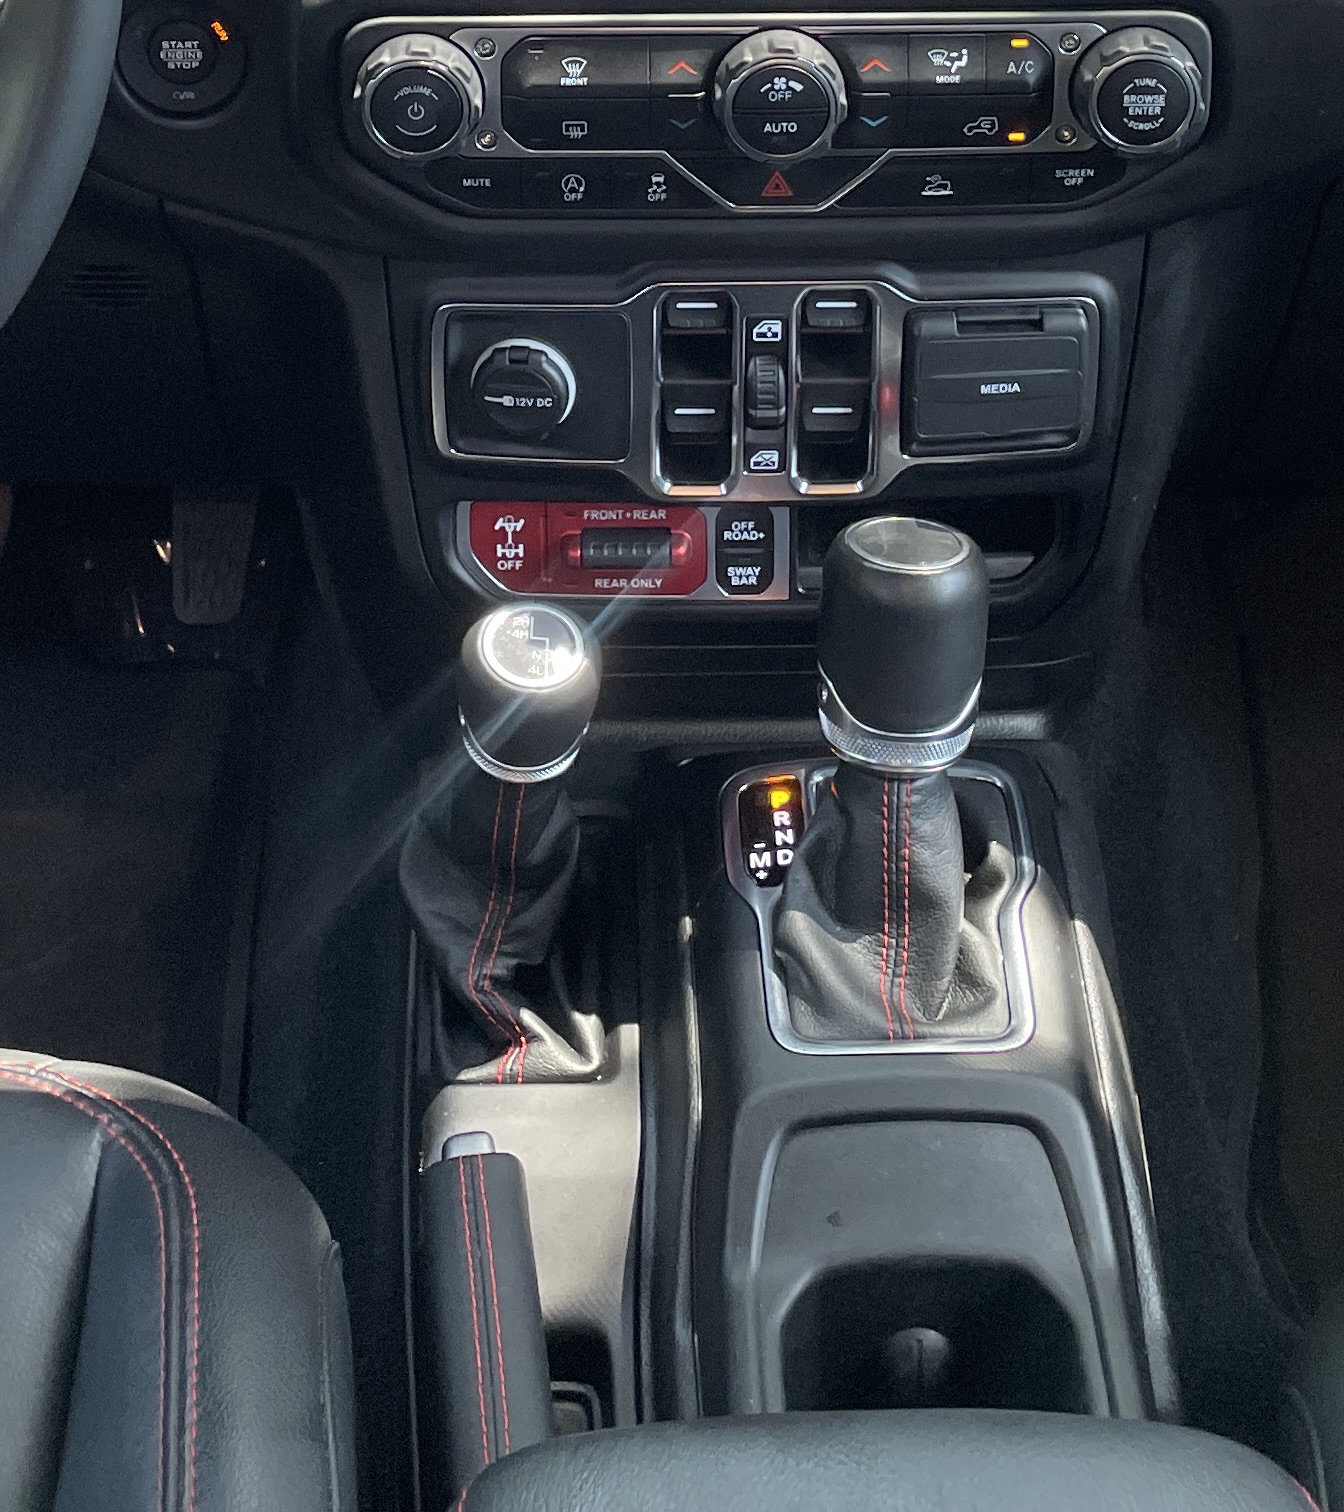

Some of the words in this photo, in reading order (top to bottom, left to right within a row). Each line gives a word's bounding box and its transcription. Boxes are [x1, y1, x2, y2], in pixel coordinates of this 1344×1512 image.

[161, 40, 200, 49] START
[159, 50, 204, 60] ENGINE
[167, 61, 200, 69] STOP
[1006, 60, 1035, 75] A/C
[560, 76, 589, 86] FRONT
[935, 75, 960, 84] MODE
[1133, 77, 1158, 88] TUNE
[397, 85, 433, 97] VOLUME
[768, 91, 793, 103] OFF
[1123, 94, 1166, 104] BROWSE
[1128, 107, 1162, 116] ENTER
[764, 122, 797, 133] AUTO
[1127, 119, 1161, 131] SCROLL
[1055, 168, 1094, 179] SCREEN
[462, 178, 492, 187] MUTE
[1064, 176, 1084, 187] OFF
[563, 192, 583, 202] OFF
[647, 192, 667, 202] OFF
[979, 382, 1021, 395] MEDIA
[515, 396, 534, 408] 12V
[536, 396, 553, 408] DC
[731, 521, 755, 531] OFF
[497, 560, 523, 571] OFF
[727, 566, 761, 577] SWAY
[595, 578, 630, 588] REAR
[631, 577, 663, 589] ONLY
[731, 575, 757, 585] BAR
[528, 665, 544, 676] 4L
[770, 790, 791, 809] P
[773, 810, 791, 827] R
[774, 829, 794, 846] N
[749, 851, 772, 869] M
[776, 848, 794, 867] D
